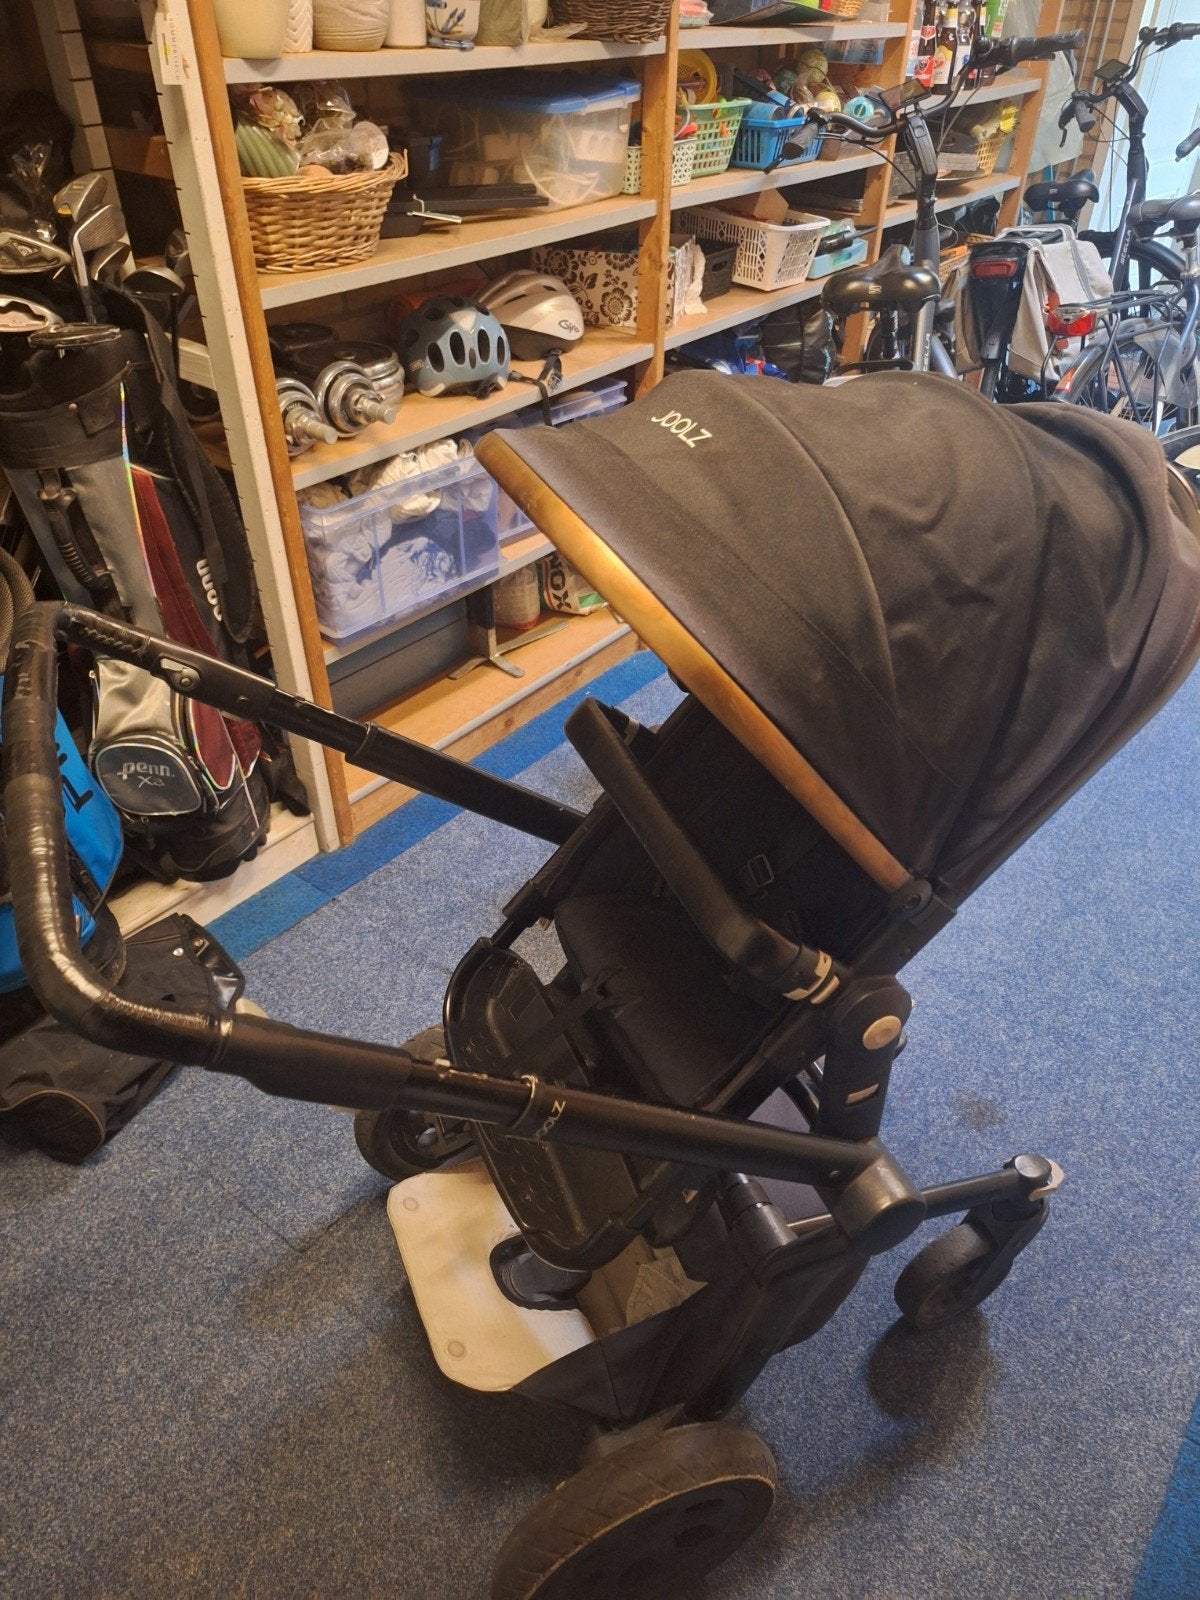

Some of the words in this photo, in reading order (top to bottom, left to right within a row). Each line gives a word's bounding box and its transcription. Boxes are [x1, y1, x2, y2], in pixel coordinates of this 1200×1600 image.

[558, 319, 580, 334] Giro
[650, 410, 713, 449] JOOLZ
[116, 761, 171, 781] penn
